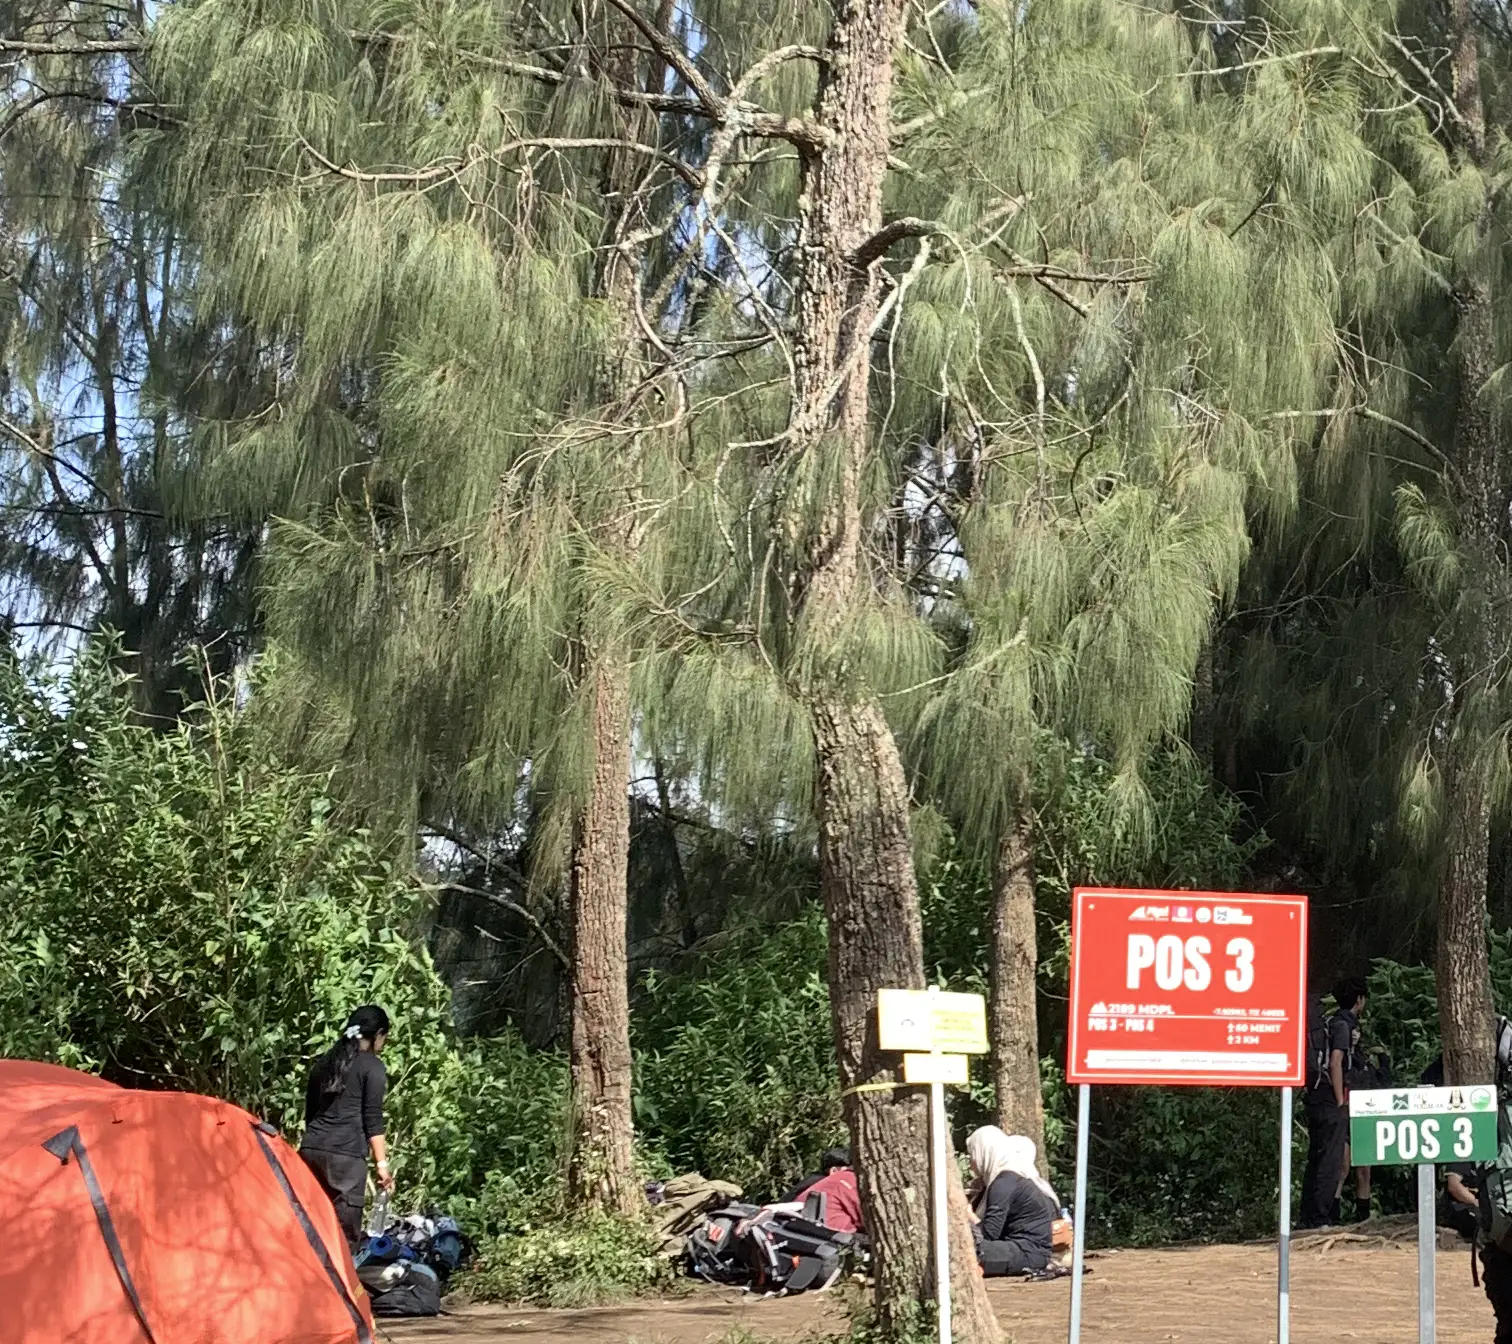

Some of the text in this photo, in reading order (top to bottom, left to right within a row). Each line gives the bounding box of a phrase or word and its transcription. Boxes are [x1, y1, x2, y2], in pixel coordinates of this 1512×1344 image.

[1126, 934, 1255, 993] POS 3
[1376, 1117, 1473, 1161] POS 3
